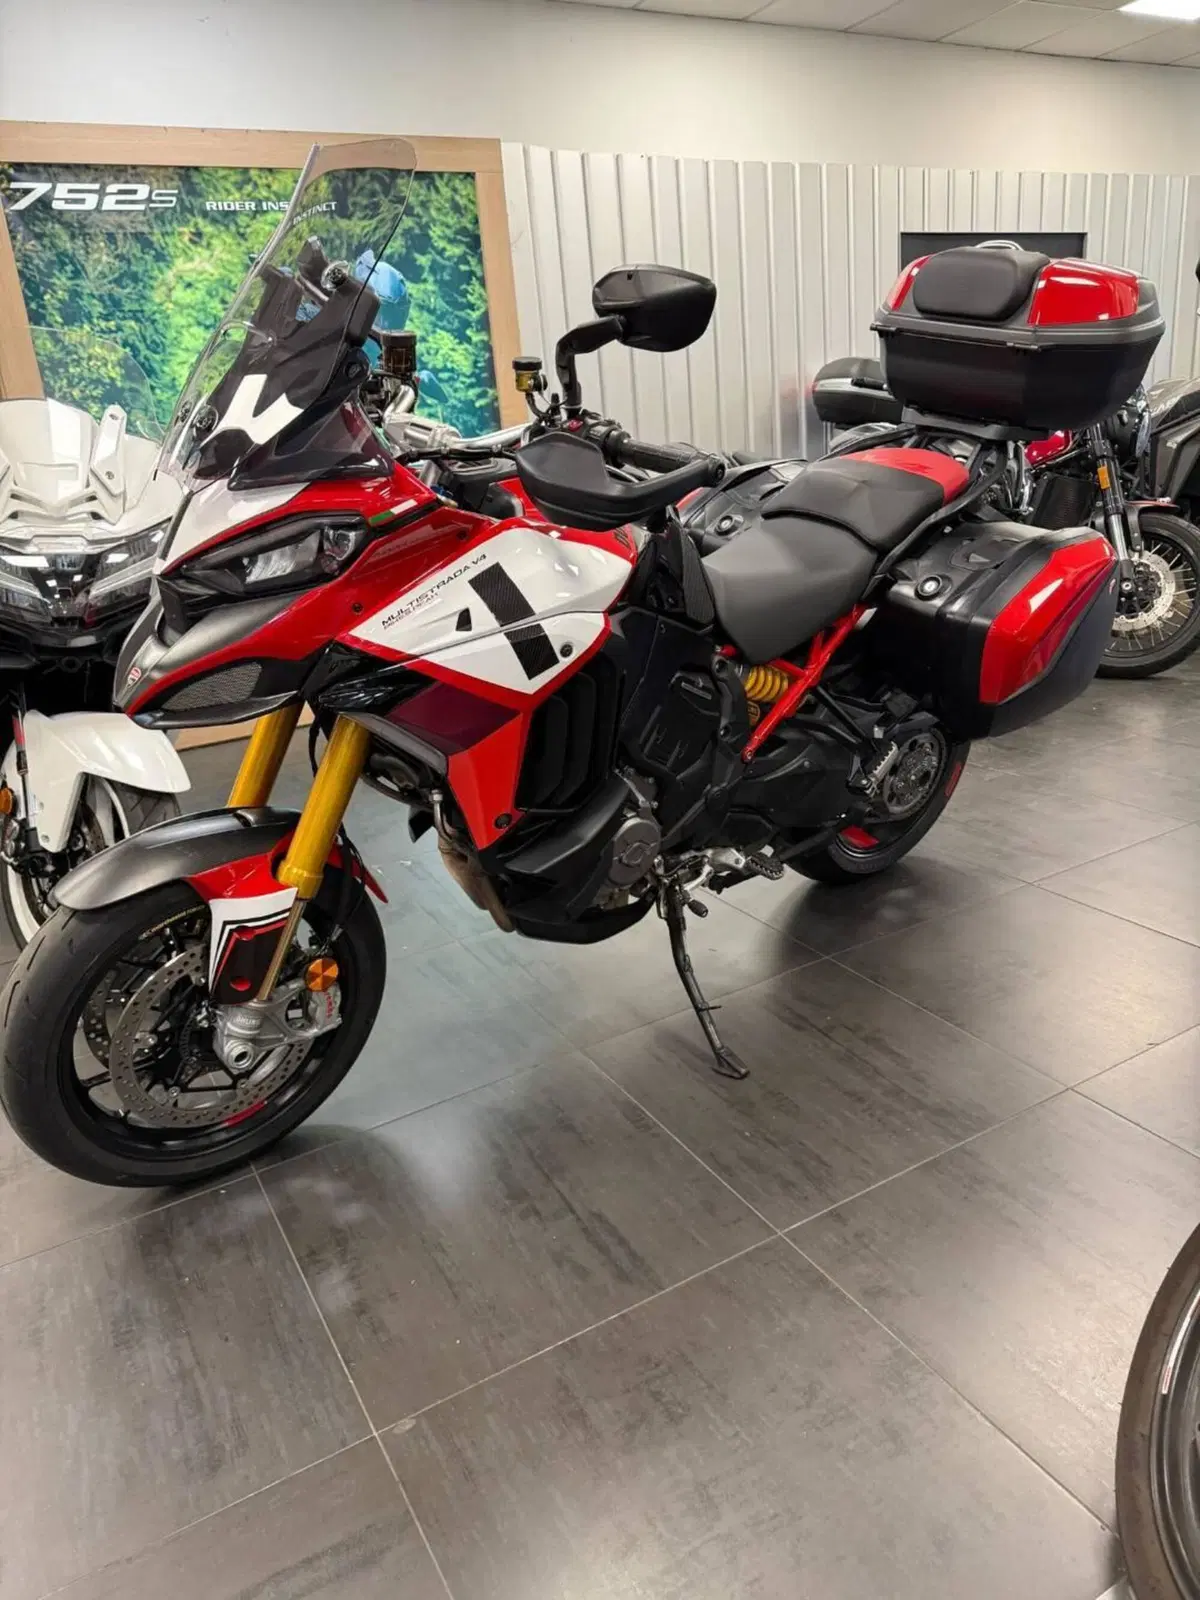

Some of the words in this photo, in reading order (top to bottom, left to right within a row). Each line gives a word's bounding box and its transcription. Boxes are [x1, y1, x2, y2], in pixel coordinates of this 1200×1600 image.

[205, 201, 256, 211] RIDER
[381, 564, 470, 627] MULTISTRADA
[471, 553, 487, 565] V4
